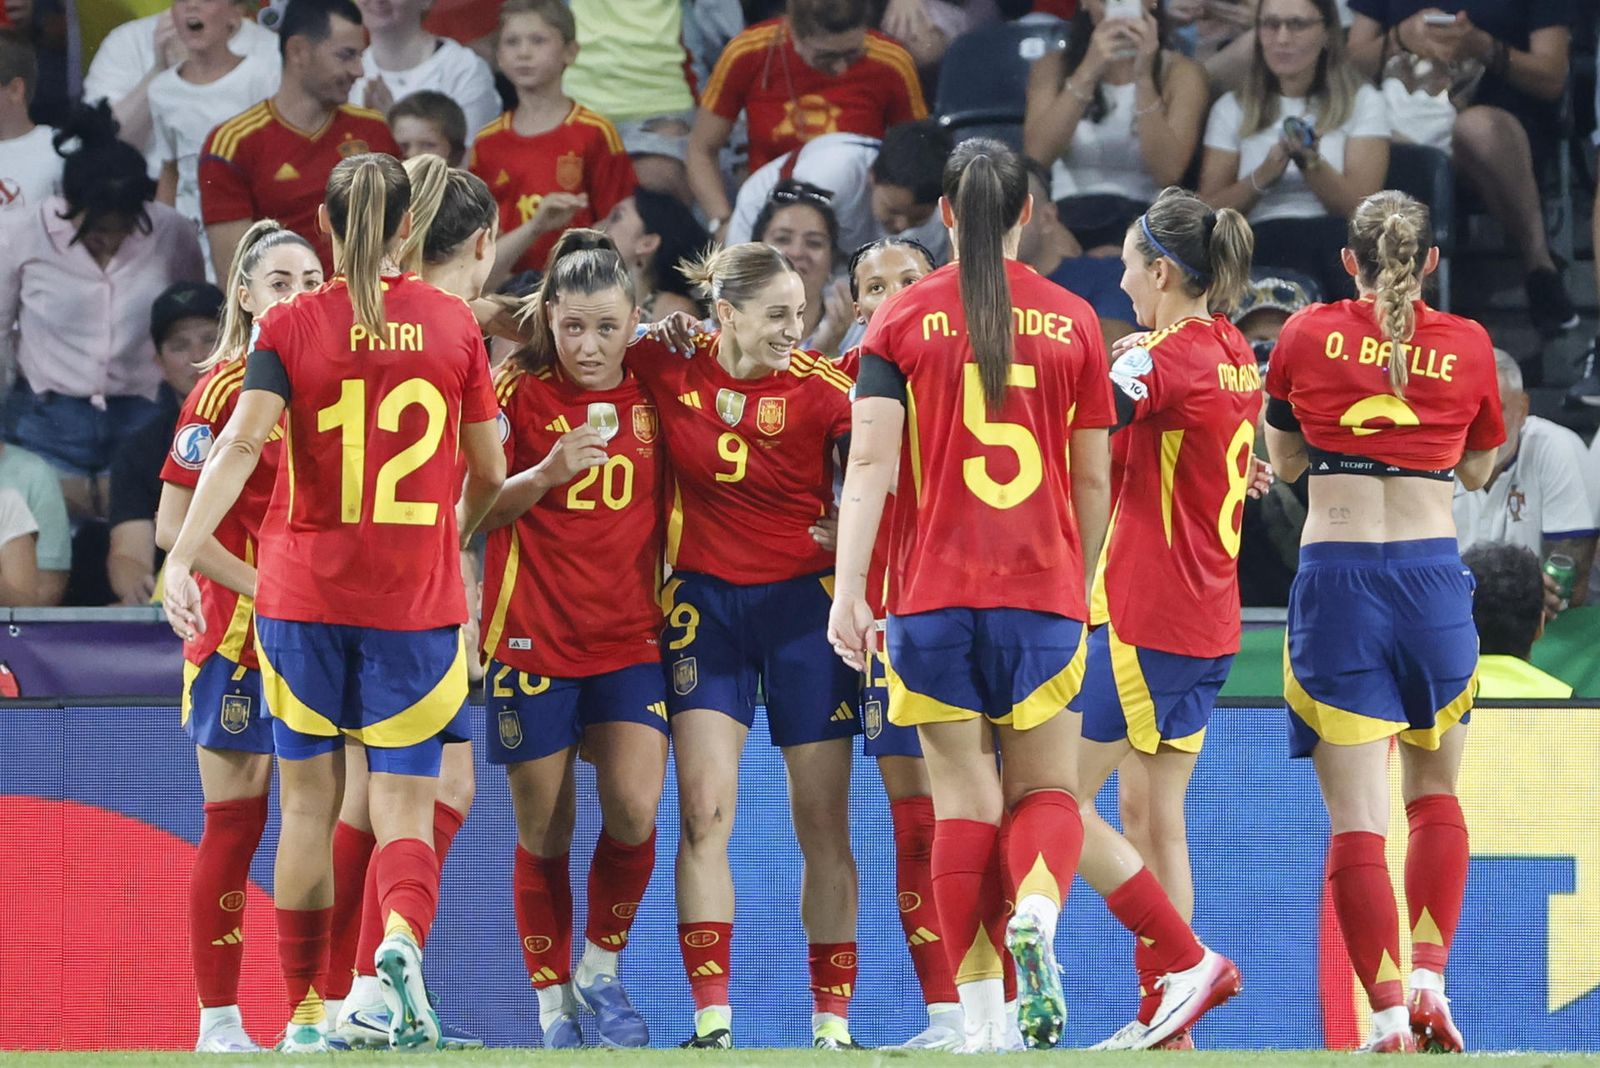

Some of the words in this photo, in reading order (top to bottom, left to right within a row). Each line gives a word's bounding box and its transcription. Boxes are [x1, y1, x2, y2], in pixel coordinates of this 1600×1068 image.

[1325, 331, 1349, 361] O.
[317, 377, 448, 526] 12
[715, 431, 749, 483] 9
[963, 362, 1043, 510] 5
[566, 454, 634, 511] 20
[1218, 418, 1255, 560] 8
[669, 602, 700, 650] 9
